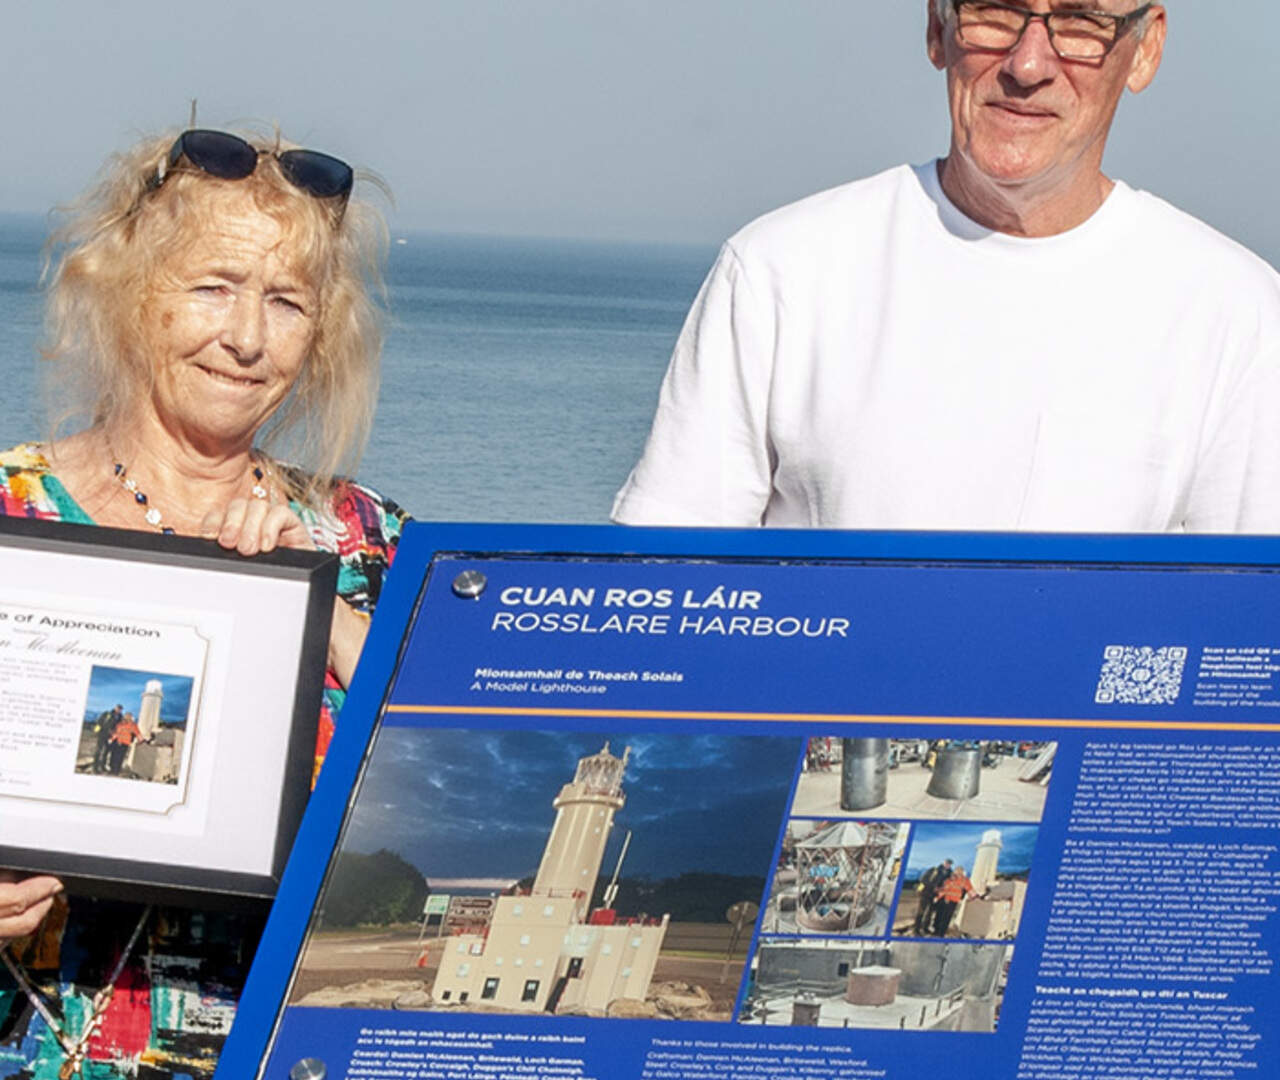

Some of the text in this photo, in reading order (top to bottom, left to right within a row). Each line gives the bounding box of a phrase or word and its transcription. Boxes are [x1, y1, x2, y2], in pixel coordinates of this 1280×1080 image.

[498, 585, 763, 609] CUAN ROS LÁIR
[13, 613, 34, 625] of
[38, 616, 161, 640] Appreciation
[490, 611, 851, 637] ROSSLARE HARBOUR
[473, 667, 684, 682] Mionsamhail de Theach Solais
[470, 680, 607, 694] A Model Lighthouse
[1034, 985, 1228, 1000] Teacht an chogaidh go dtí an Tuscar
